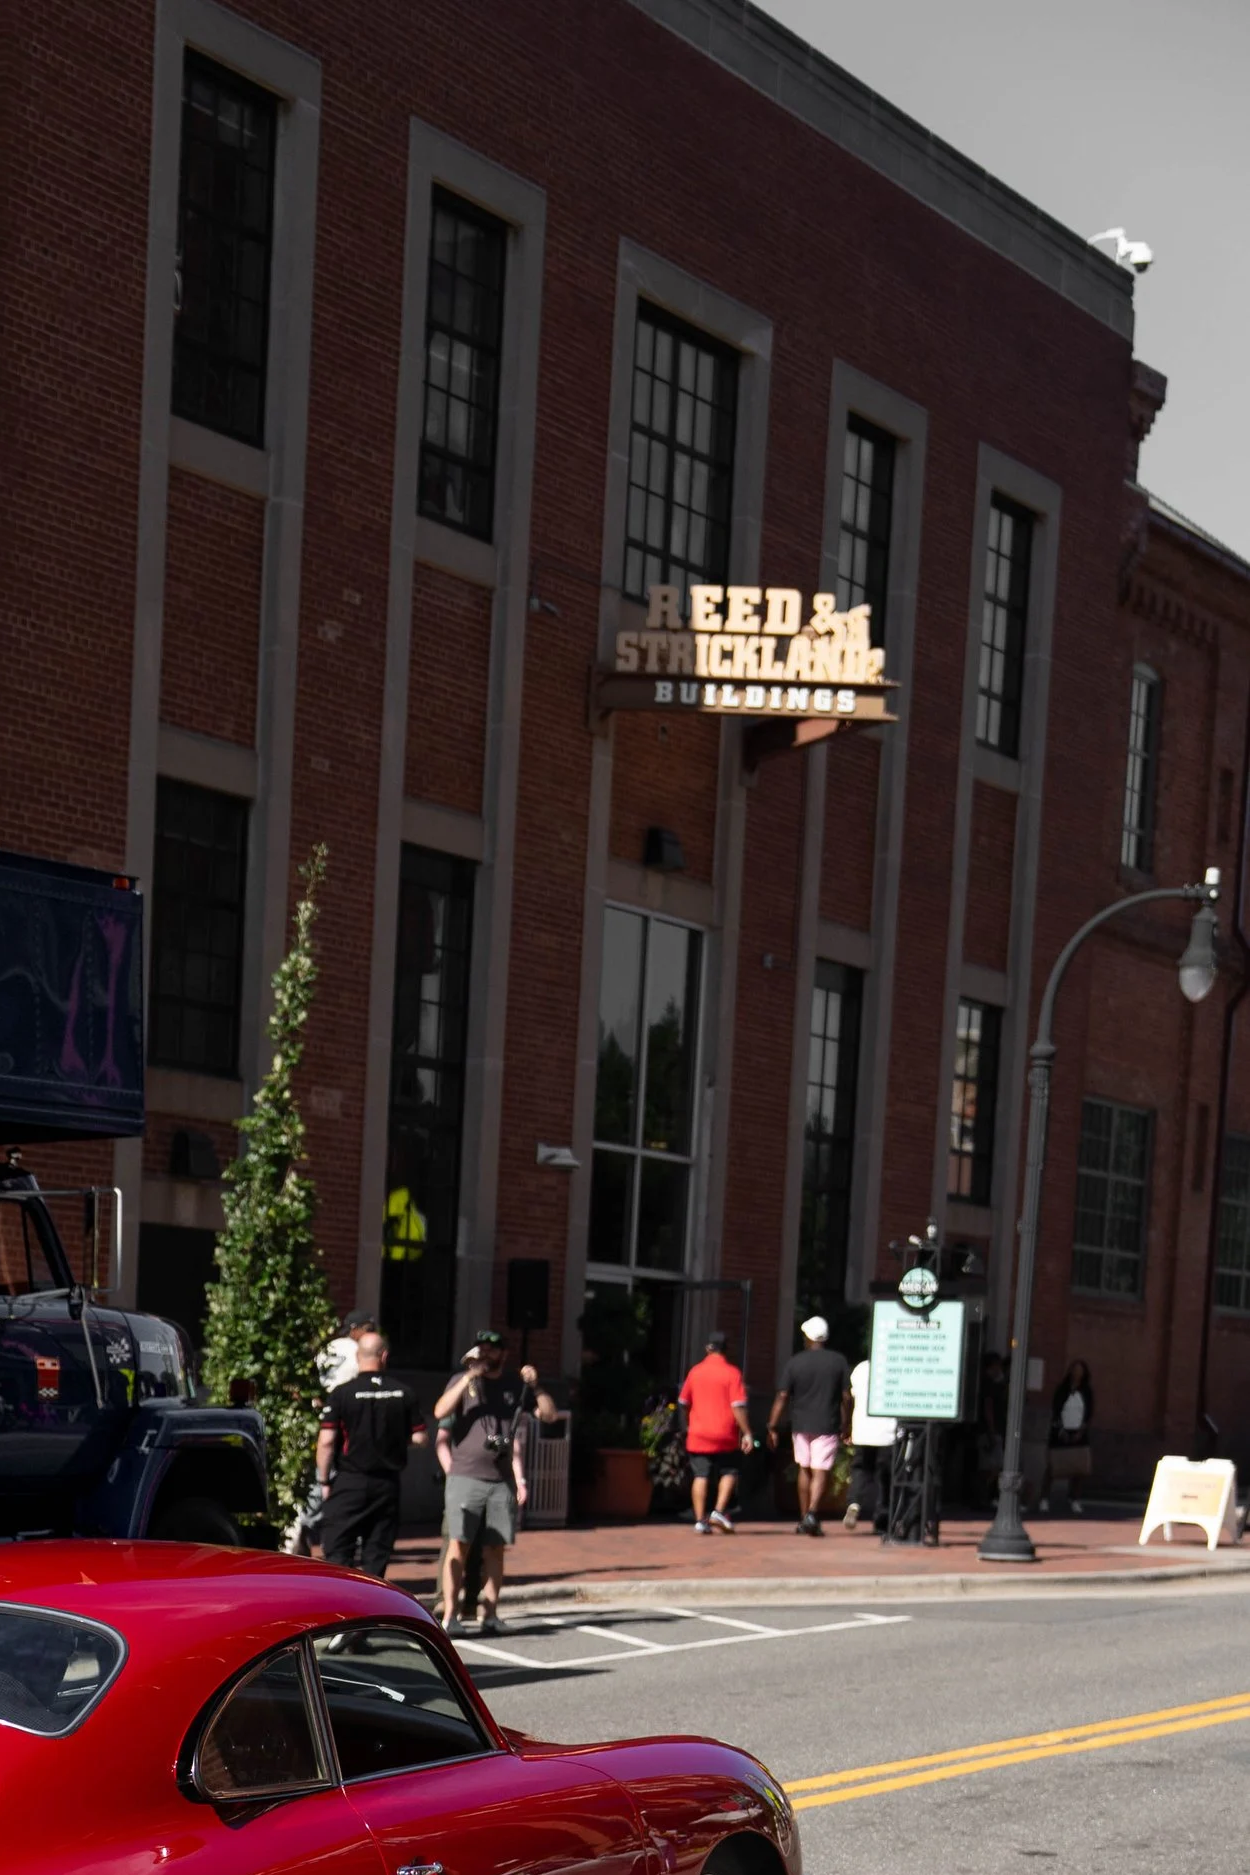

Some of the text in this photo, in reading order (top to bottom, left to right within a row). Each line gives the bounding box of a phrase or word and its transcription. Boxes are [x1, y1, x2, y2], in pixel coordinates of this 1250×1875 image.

[647, 584, 802, 636] REED
[615, 631, 868, 683] STRICKLAND
[654, 682, 856, 714] BUILDINGS
